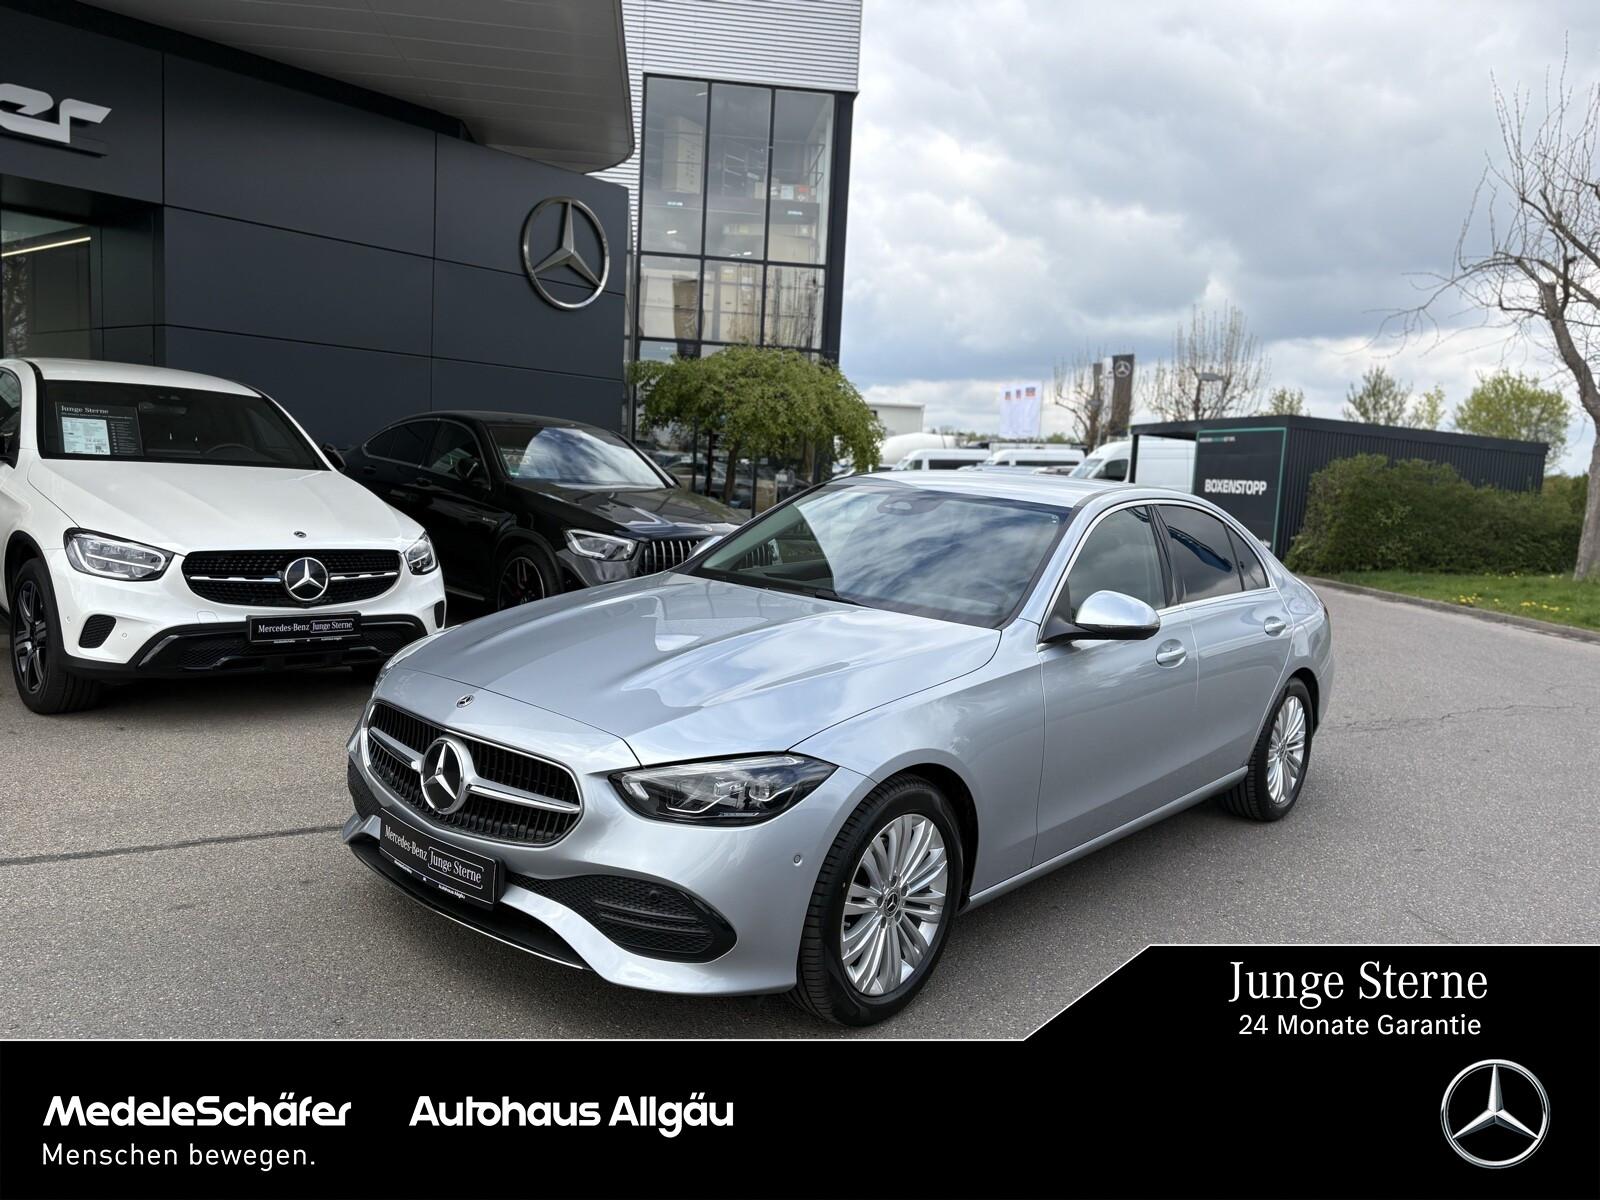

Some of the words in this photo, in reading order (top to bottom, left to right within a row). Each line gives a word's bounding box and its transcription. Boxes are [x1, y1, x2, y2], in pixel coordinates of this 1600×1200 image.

[1204, 478, 1267, 496] BOXENSTOPP
[258, 623, 310, 633] Mercedes-Benz
[312, 622, 331, 631] Junge
[331, 620, 353, 630] Sterne
[385, 824, 428, 861] Mercedes-Benz
[429, 850, 452, 872] Junge
[453, 861, 482, 883] Sterne
